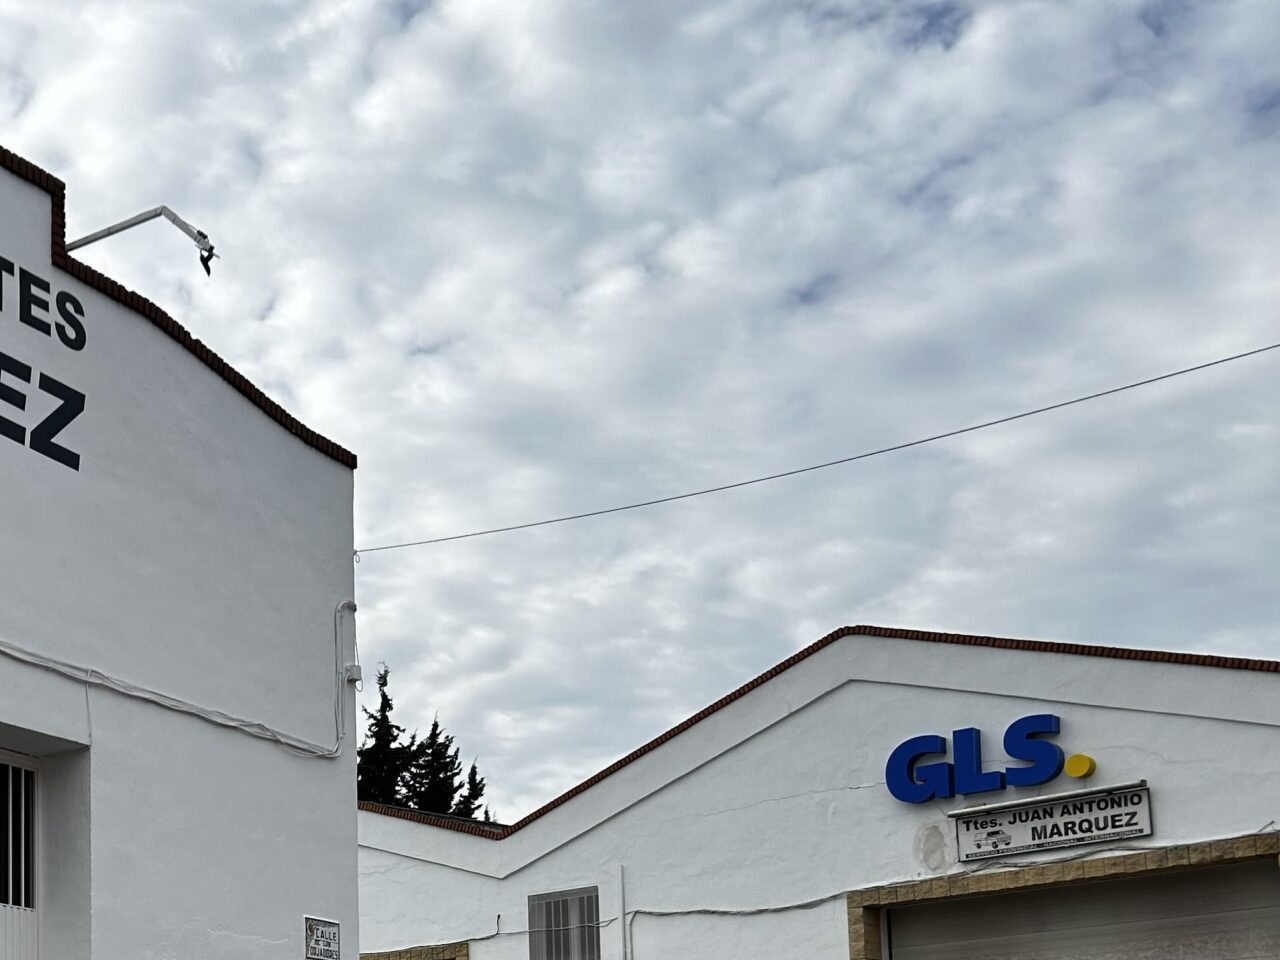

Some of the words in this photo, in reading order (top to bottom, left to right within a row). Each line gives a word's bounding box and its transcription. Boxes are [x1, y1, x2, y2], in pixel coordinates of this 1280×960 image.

[962, 817, 1003, 832] Ttes.
[1008, 807, 1054, 825] JUAN
[1059, 793, 1143, 817] ANTONIO
[1031, 811, 1139, 841] MARQUEZ
[316, 927, 337, 941] CALLE
